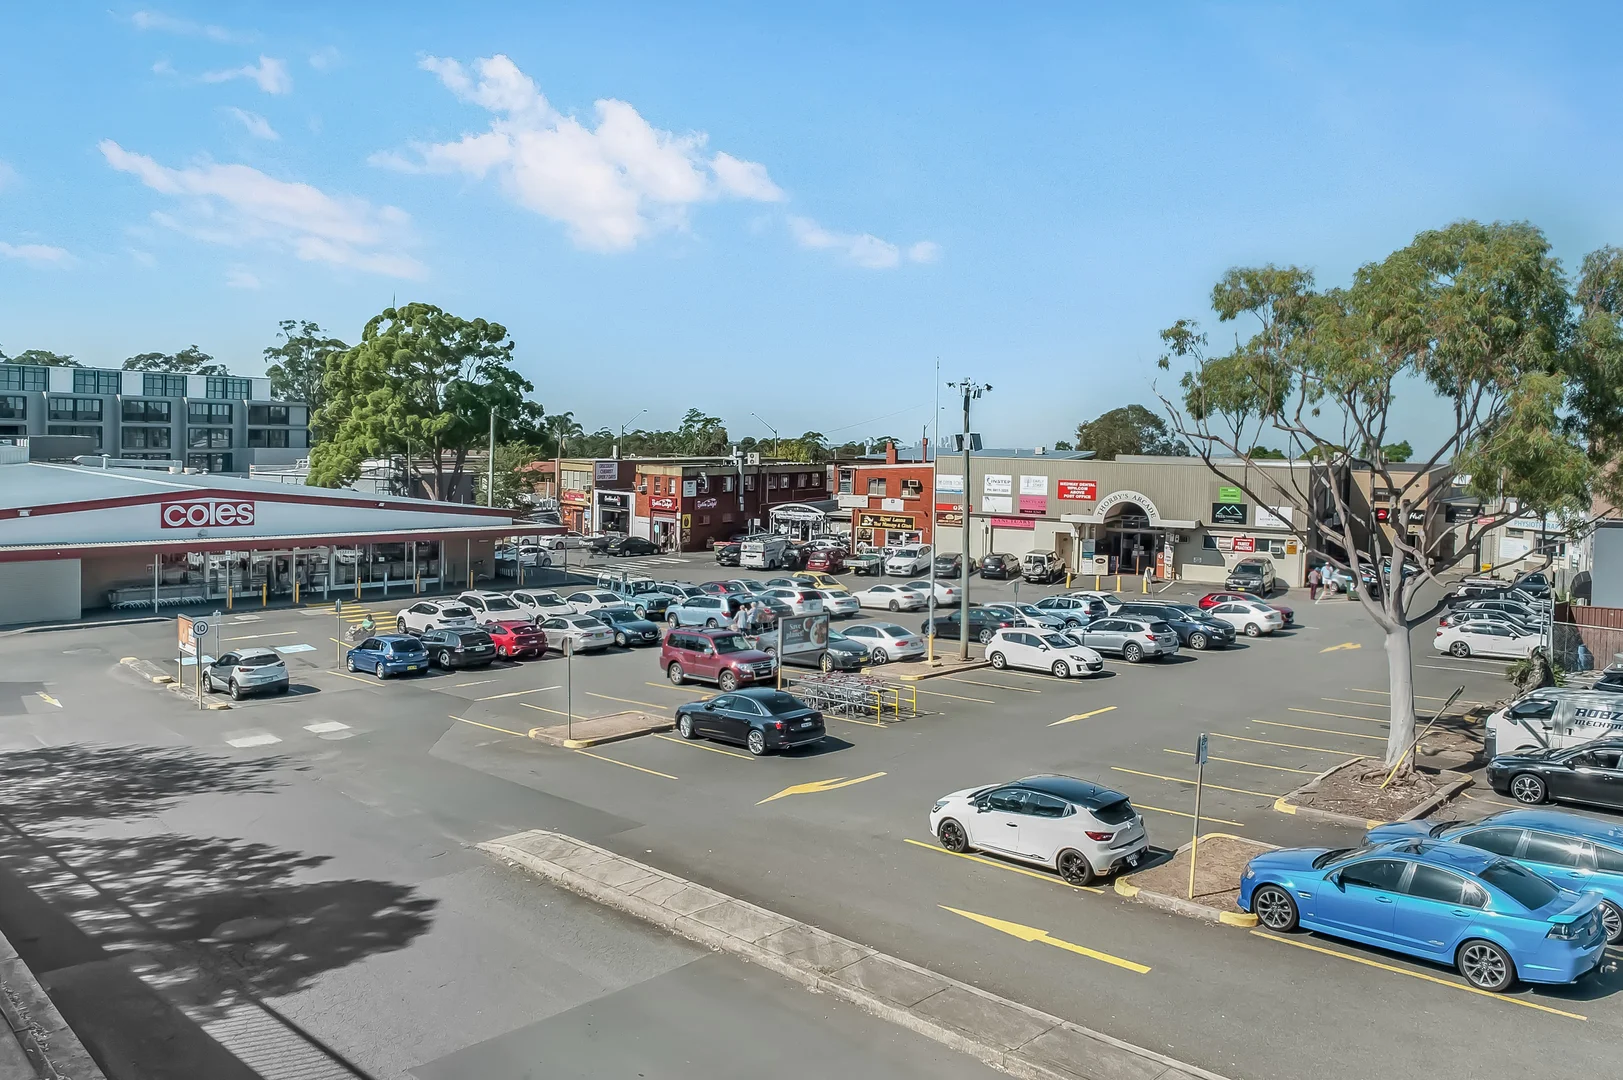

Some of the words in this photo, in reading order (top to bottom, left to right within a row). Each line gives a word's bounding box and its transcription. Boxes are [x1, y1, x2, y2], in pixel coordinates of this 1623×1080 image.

[164, 503, 254, 526] coles
[1097, 493, 1129, 516] THORBY'S
[1132, 494, 1157, 518] ARCADE
